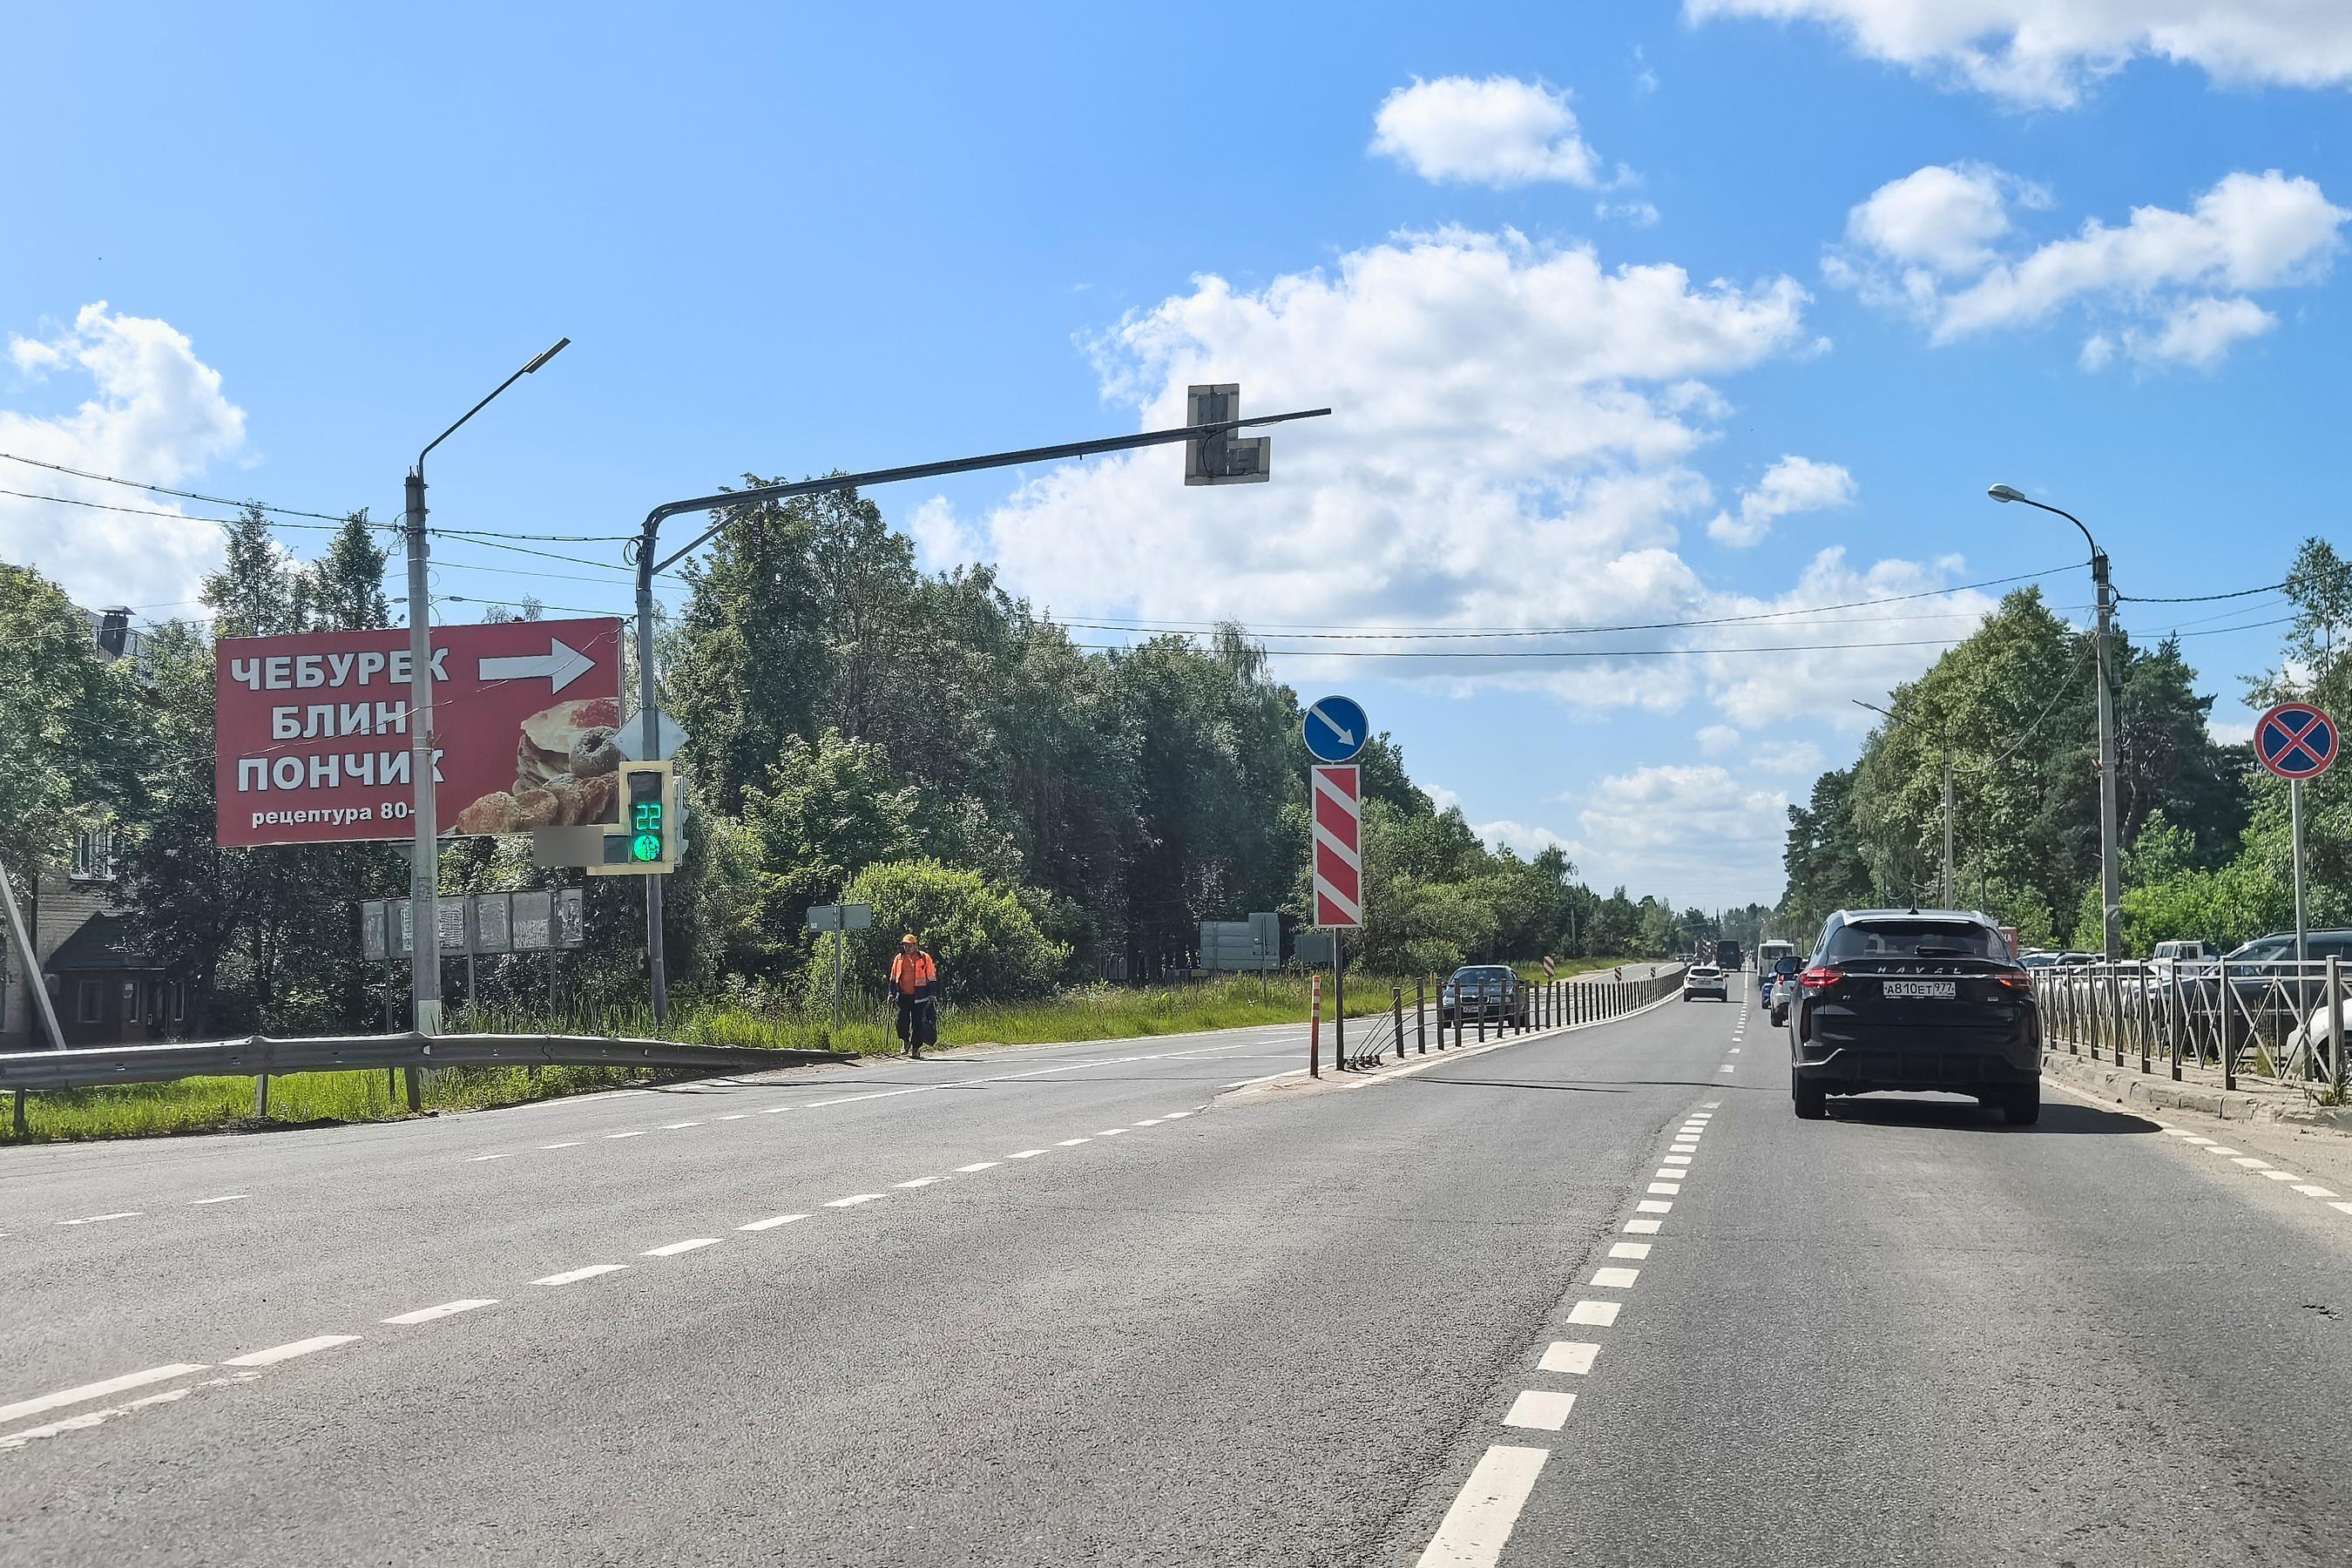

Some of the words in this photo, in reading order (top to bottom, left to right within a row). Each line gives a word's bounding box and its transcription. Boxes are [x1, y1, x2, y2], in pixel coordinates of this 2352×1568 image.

[231, 648, 449, 690] ЧЕБУРЕК
[272, 700, 406, 740] БЛИН
[252, 807, 372, 828] рецептура
[636, 805, 661, 830] 22
